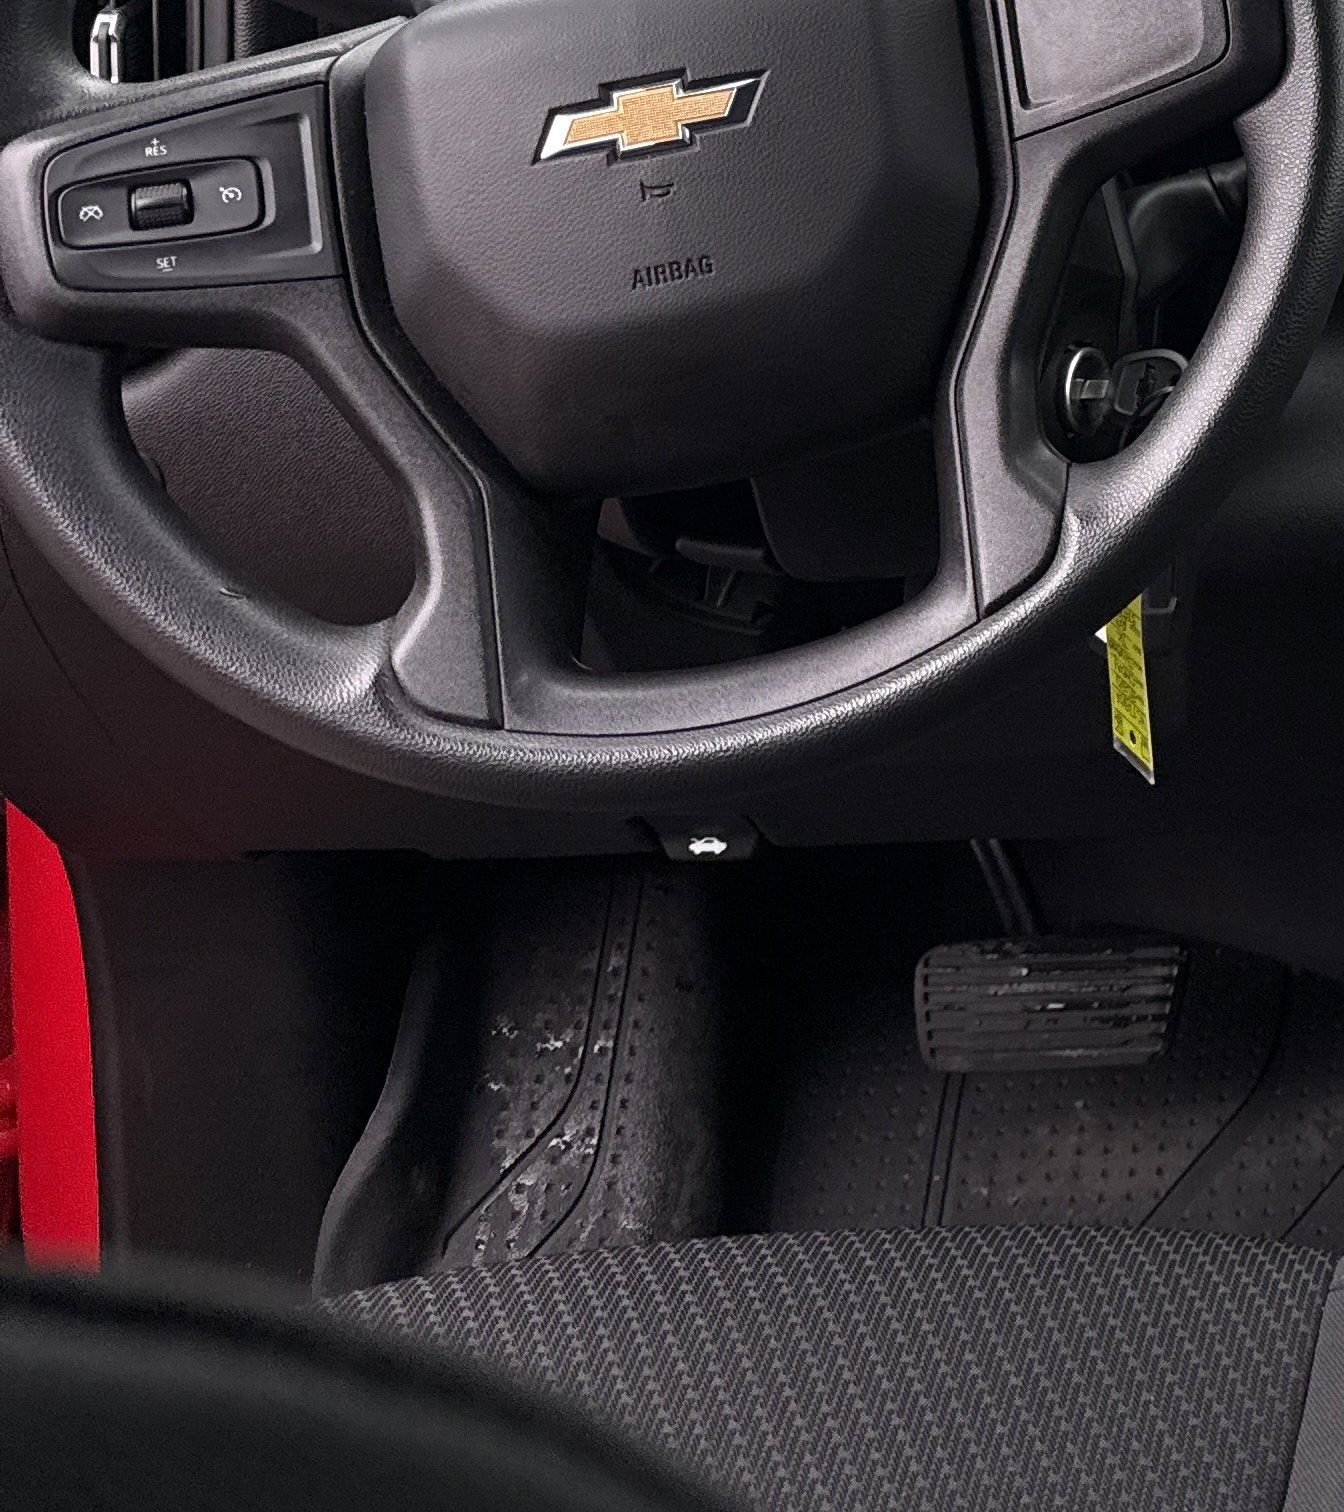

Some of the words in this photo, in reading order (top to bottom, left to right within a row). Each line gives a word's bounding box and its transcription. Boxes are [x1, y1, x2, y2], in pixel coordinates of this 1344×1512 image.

[144, 144, 168, 157] RES
[155, 256, 178, 270] SET
[631, 255, 714, 291] AIRBAG
